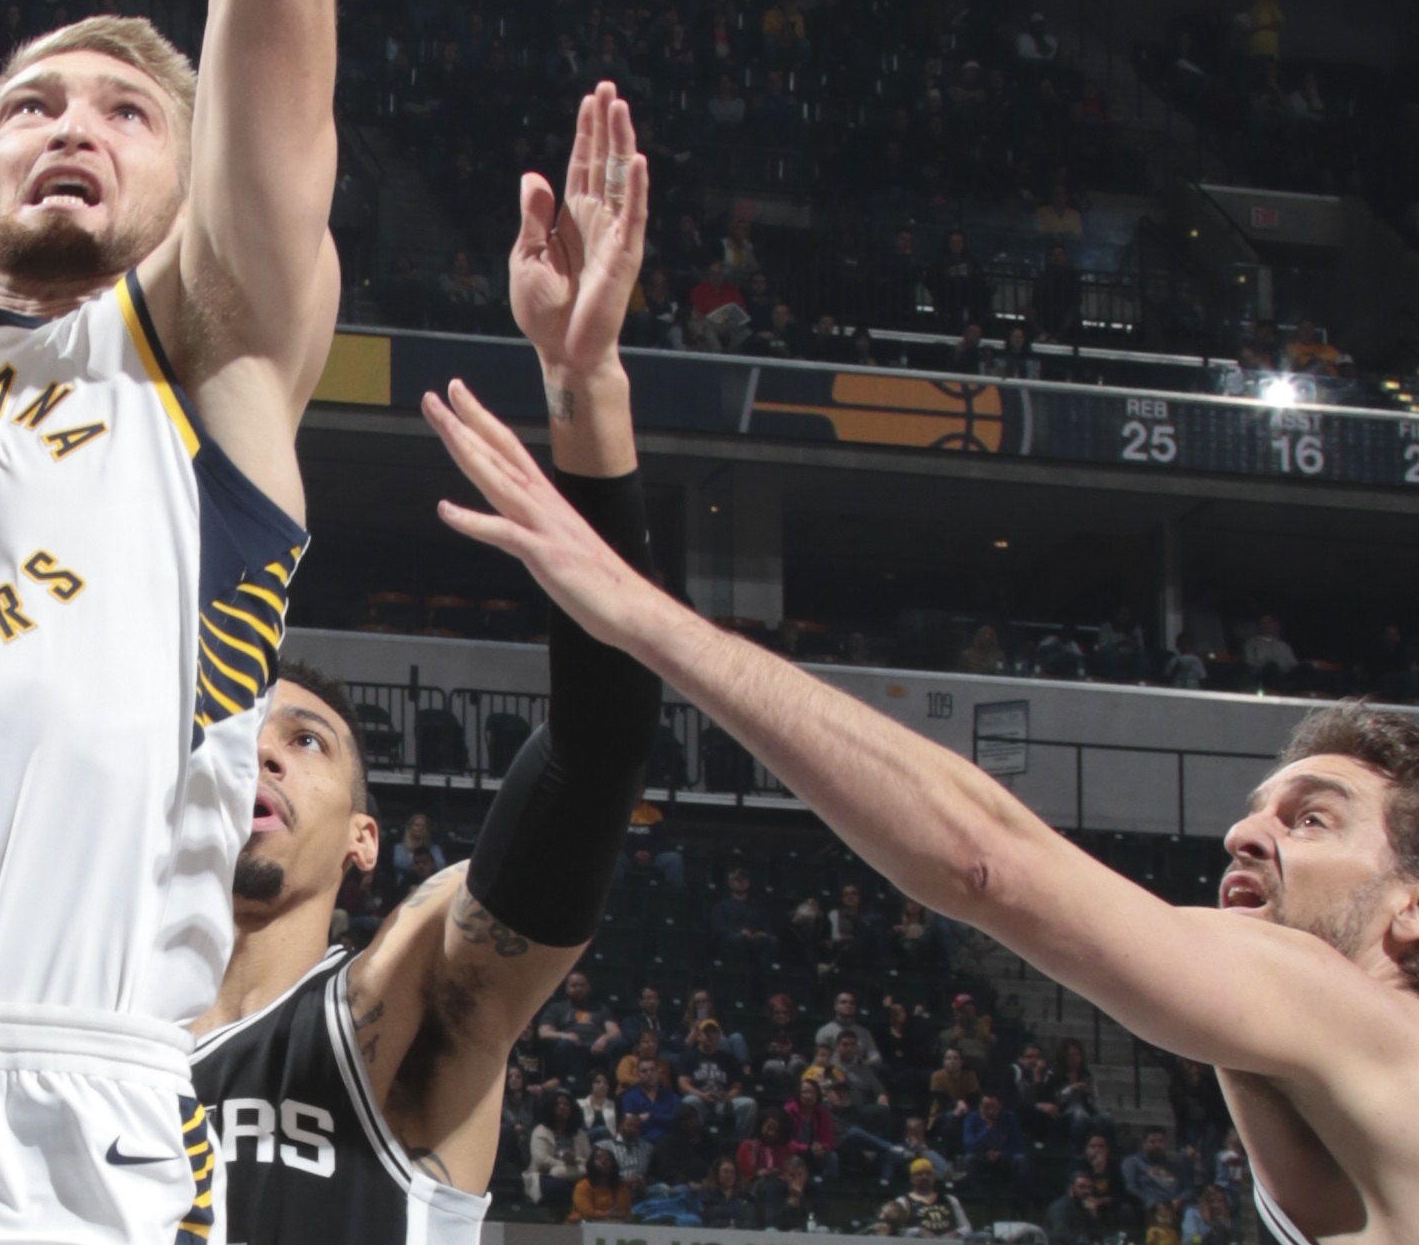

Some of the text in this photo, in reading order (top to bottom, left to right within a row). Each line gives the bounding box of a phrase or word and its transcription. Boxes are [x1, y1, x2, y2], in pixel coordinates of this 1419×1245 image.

[1126, 398, 1168, 419] REB
[1121, 420, 1177, 463] 25
[1271, 435, 1325, 474] 16
[926, 691, 954, 720] 109
